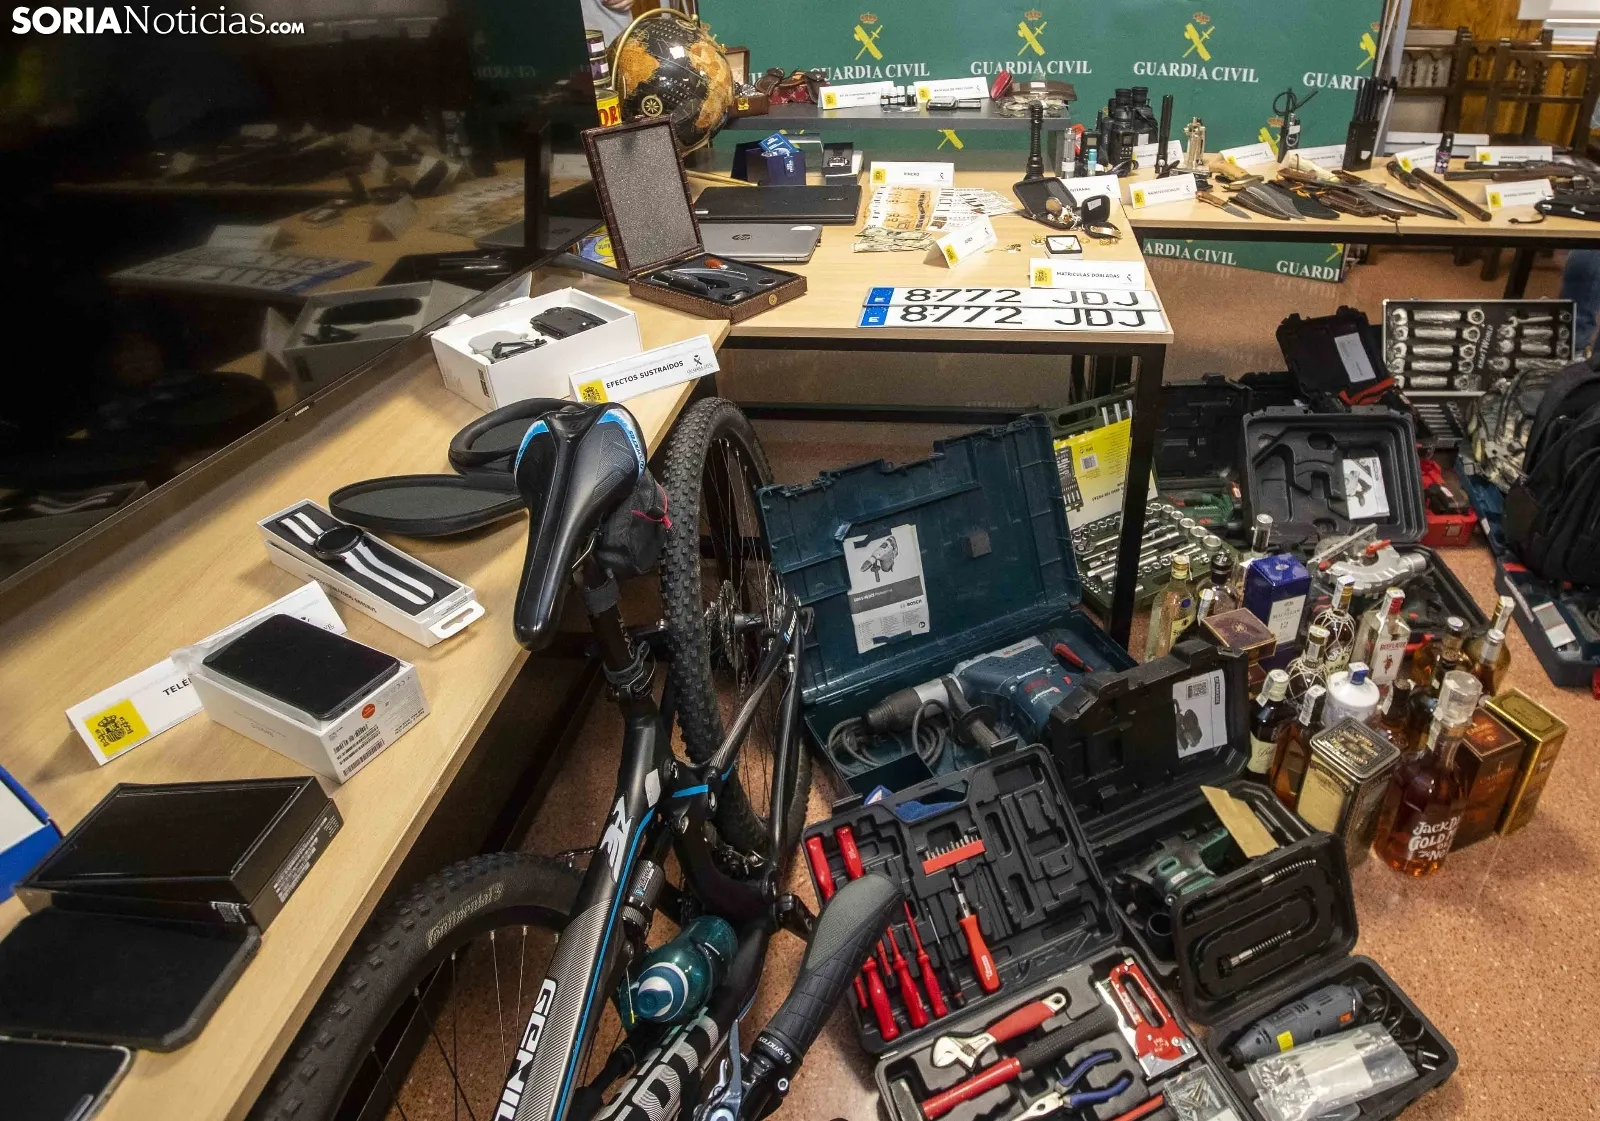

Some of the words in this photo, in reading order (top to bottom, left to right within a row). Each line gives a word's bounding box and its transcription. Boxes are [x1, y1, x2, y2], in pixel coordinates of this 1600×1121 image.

[810, 65, 883, 81] UARDIA
[886, 63, 930, 77] CIVIL
[970, 61, 1045, 75] GUARDIA
[1046, 60, 1092, 74] CIVIL
[1133, 61, 1208, 80] GUARDIA
[1212, 66, 1259, 83] CIVIL
[1303, 72, 1368, 91] GUARD
[1143, 241, 1190, 259] ARDIA
[1194, 248, 1237, 266] CIVIL
[1276, 260, 1340, 282] GUARDI
[904, 288, 1022, 304] 8772
[1052, 290, 1139, 307] JDJ
[900, 305, 1023, 325] 8772
[1055, 308, 1146, 328] JDJ
[606, 374, 639, 389] EFECTOS
[640, 360, 684, 379] SUSTRAÍDOS
